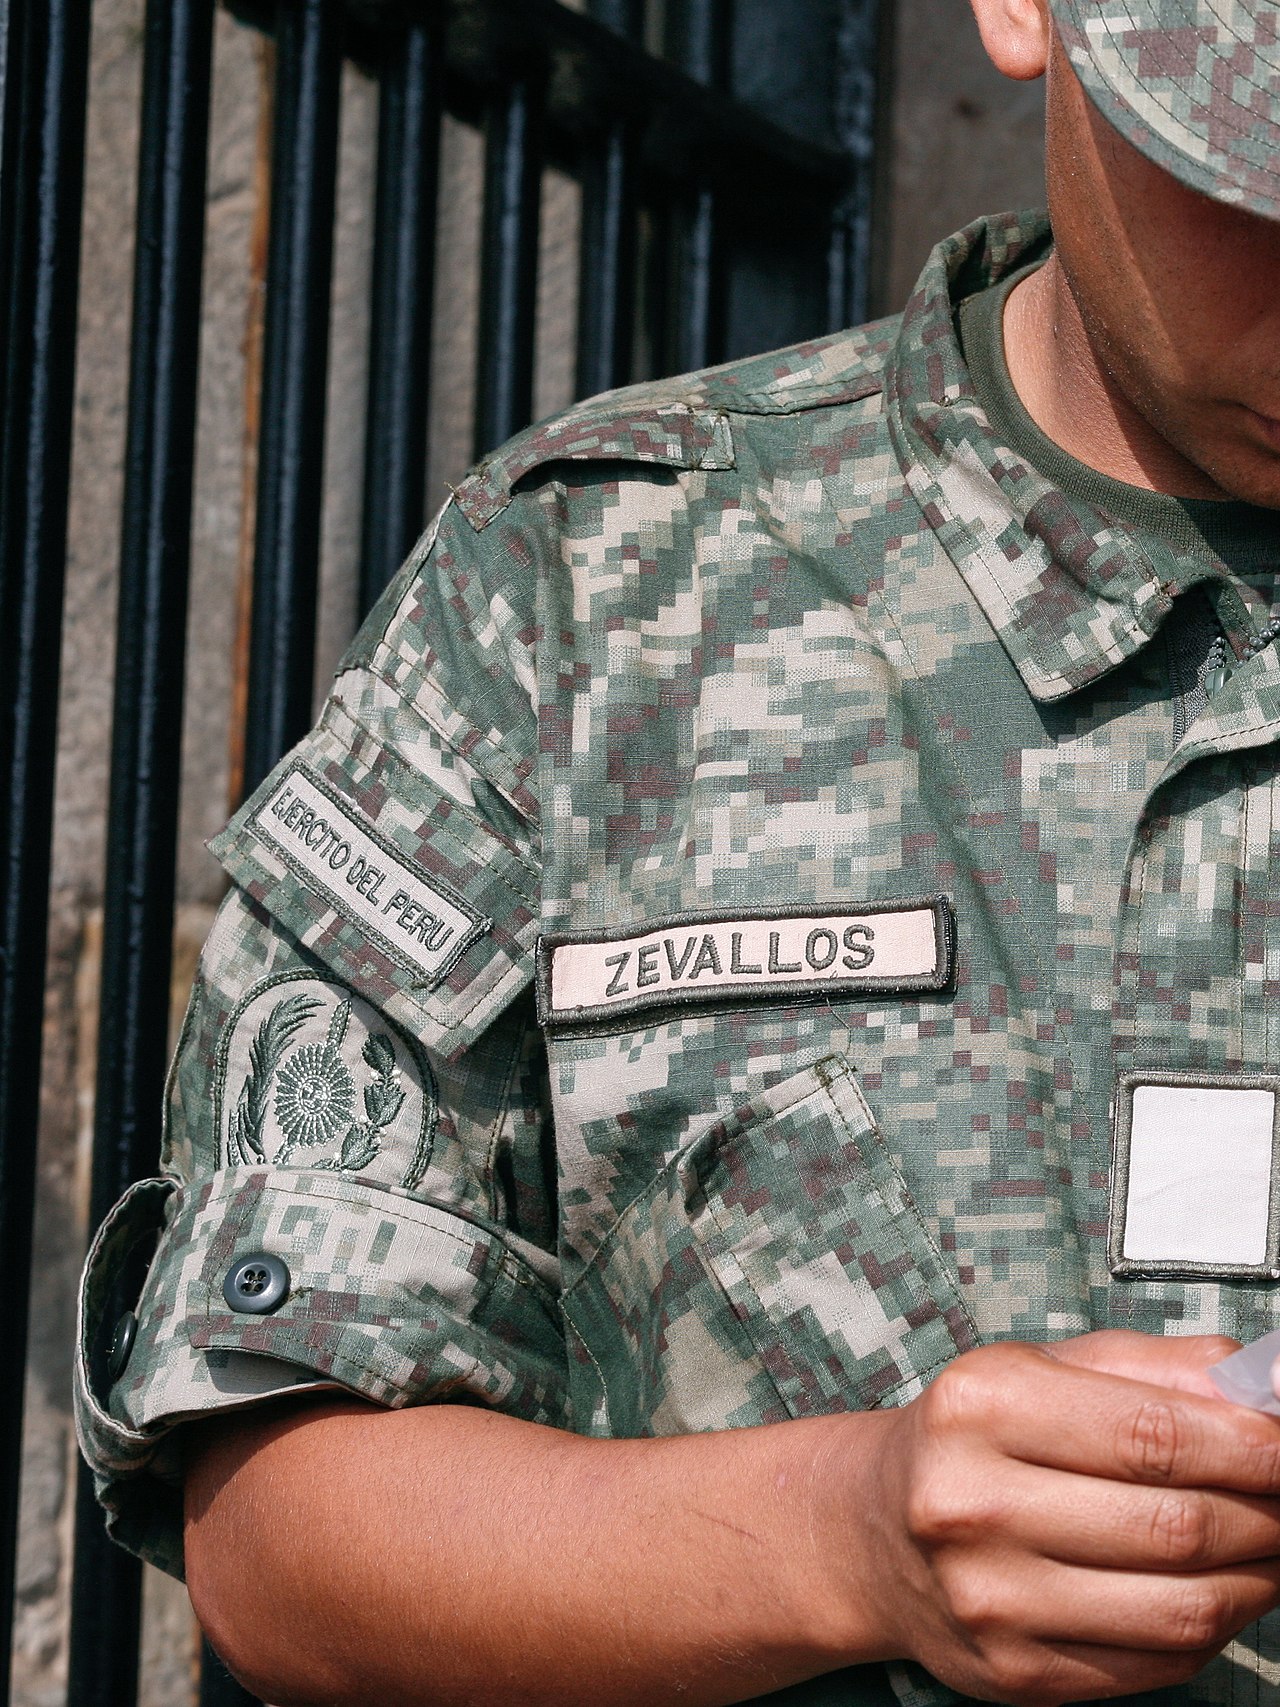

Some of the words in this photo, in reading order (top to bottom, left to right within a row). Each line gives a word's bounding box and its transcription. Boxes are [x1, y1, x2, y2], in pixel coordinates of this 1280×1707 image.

[271, 786, 352, 870] EJERCITO
[346, 854, 388, 906] DEL
[383, 888, 454, 952] PERU
[605, 924, 875, 998] ZEVALLOS
